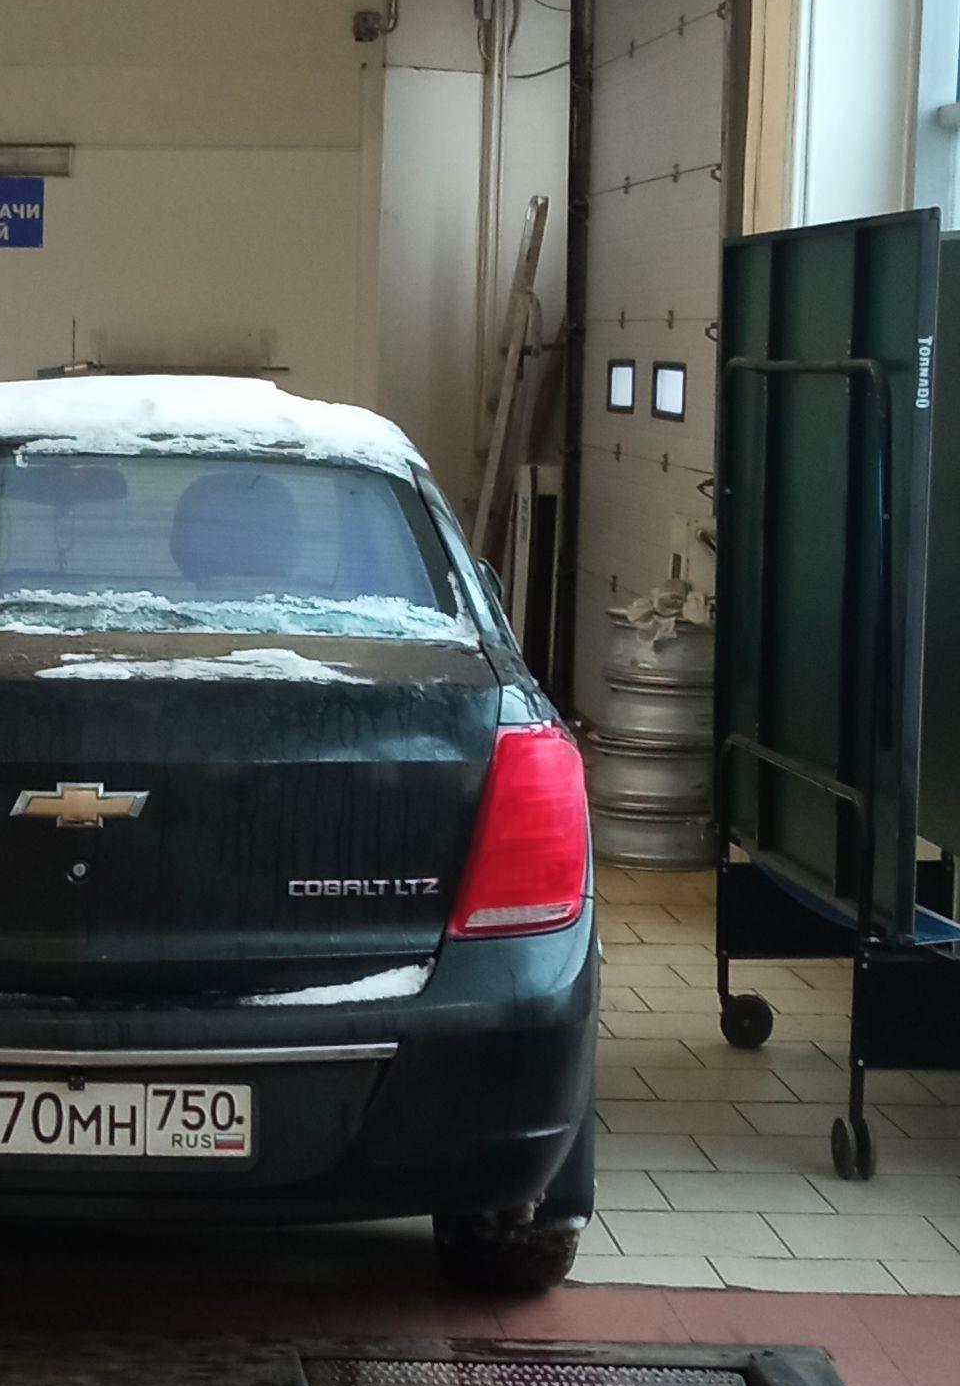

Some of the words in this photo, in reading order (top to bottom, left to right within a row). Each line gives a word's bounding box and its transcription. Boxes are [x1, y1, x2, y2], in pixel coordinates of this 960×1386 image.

[288, 879, 389, 896] COBALT
[395, 877, 439, 895] LTZ
[152, 1089, 236, 1132] 750
[171, 1133, 212, 1149] RUS
